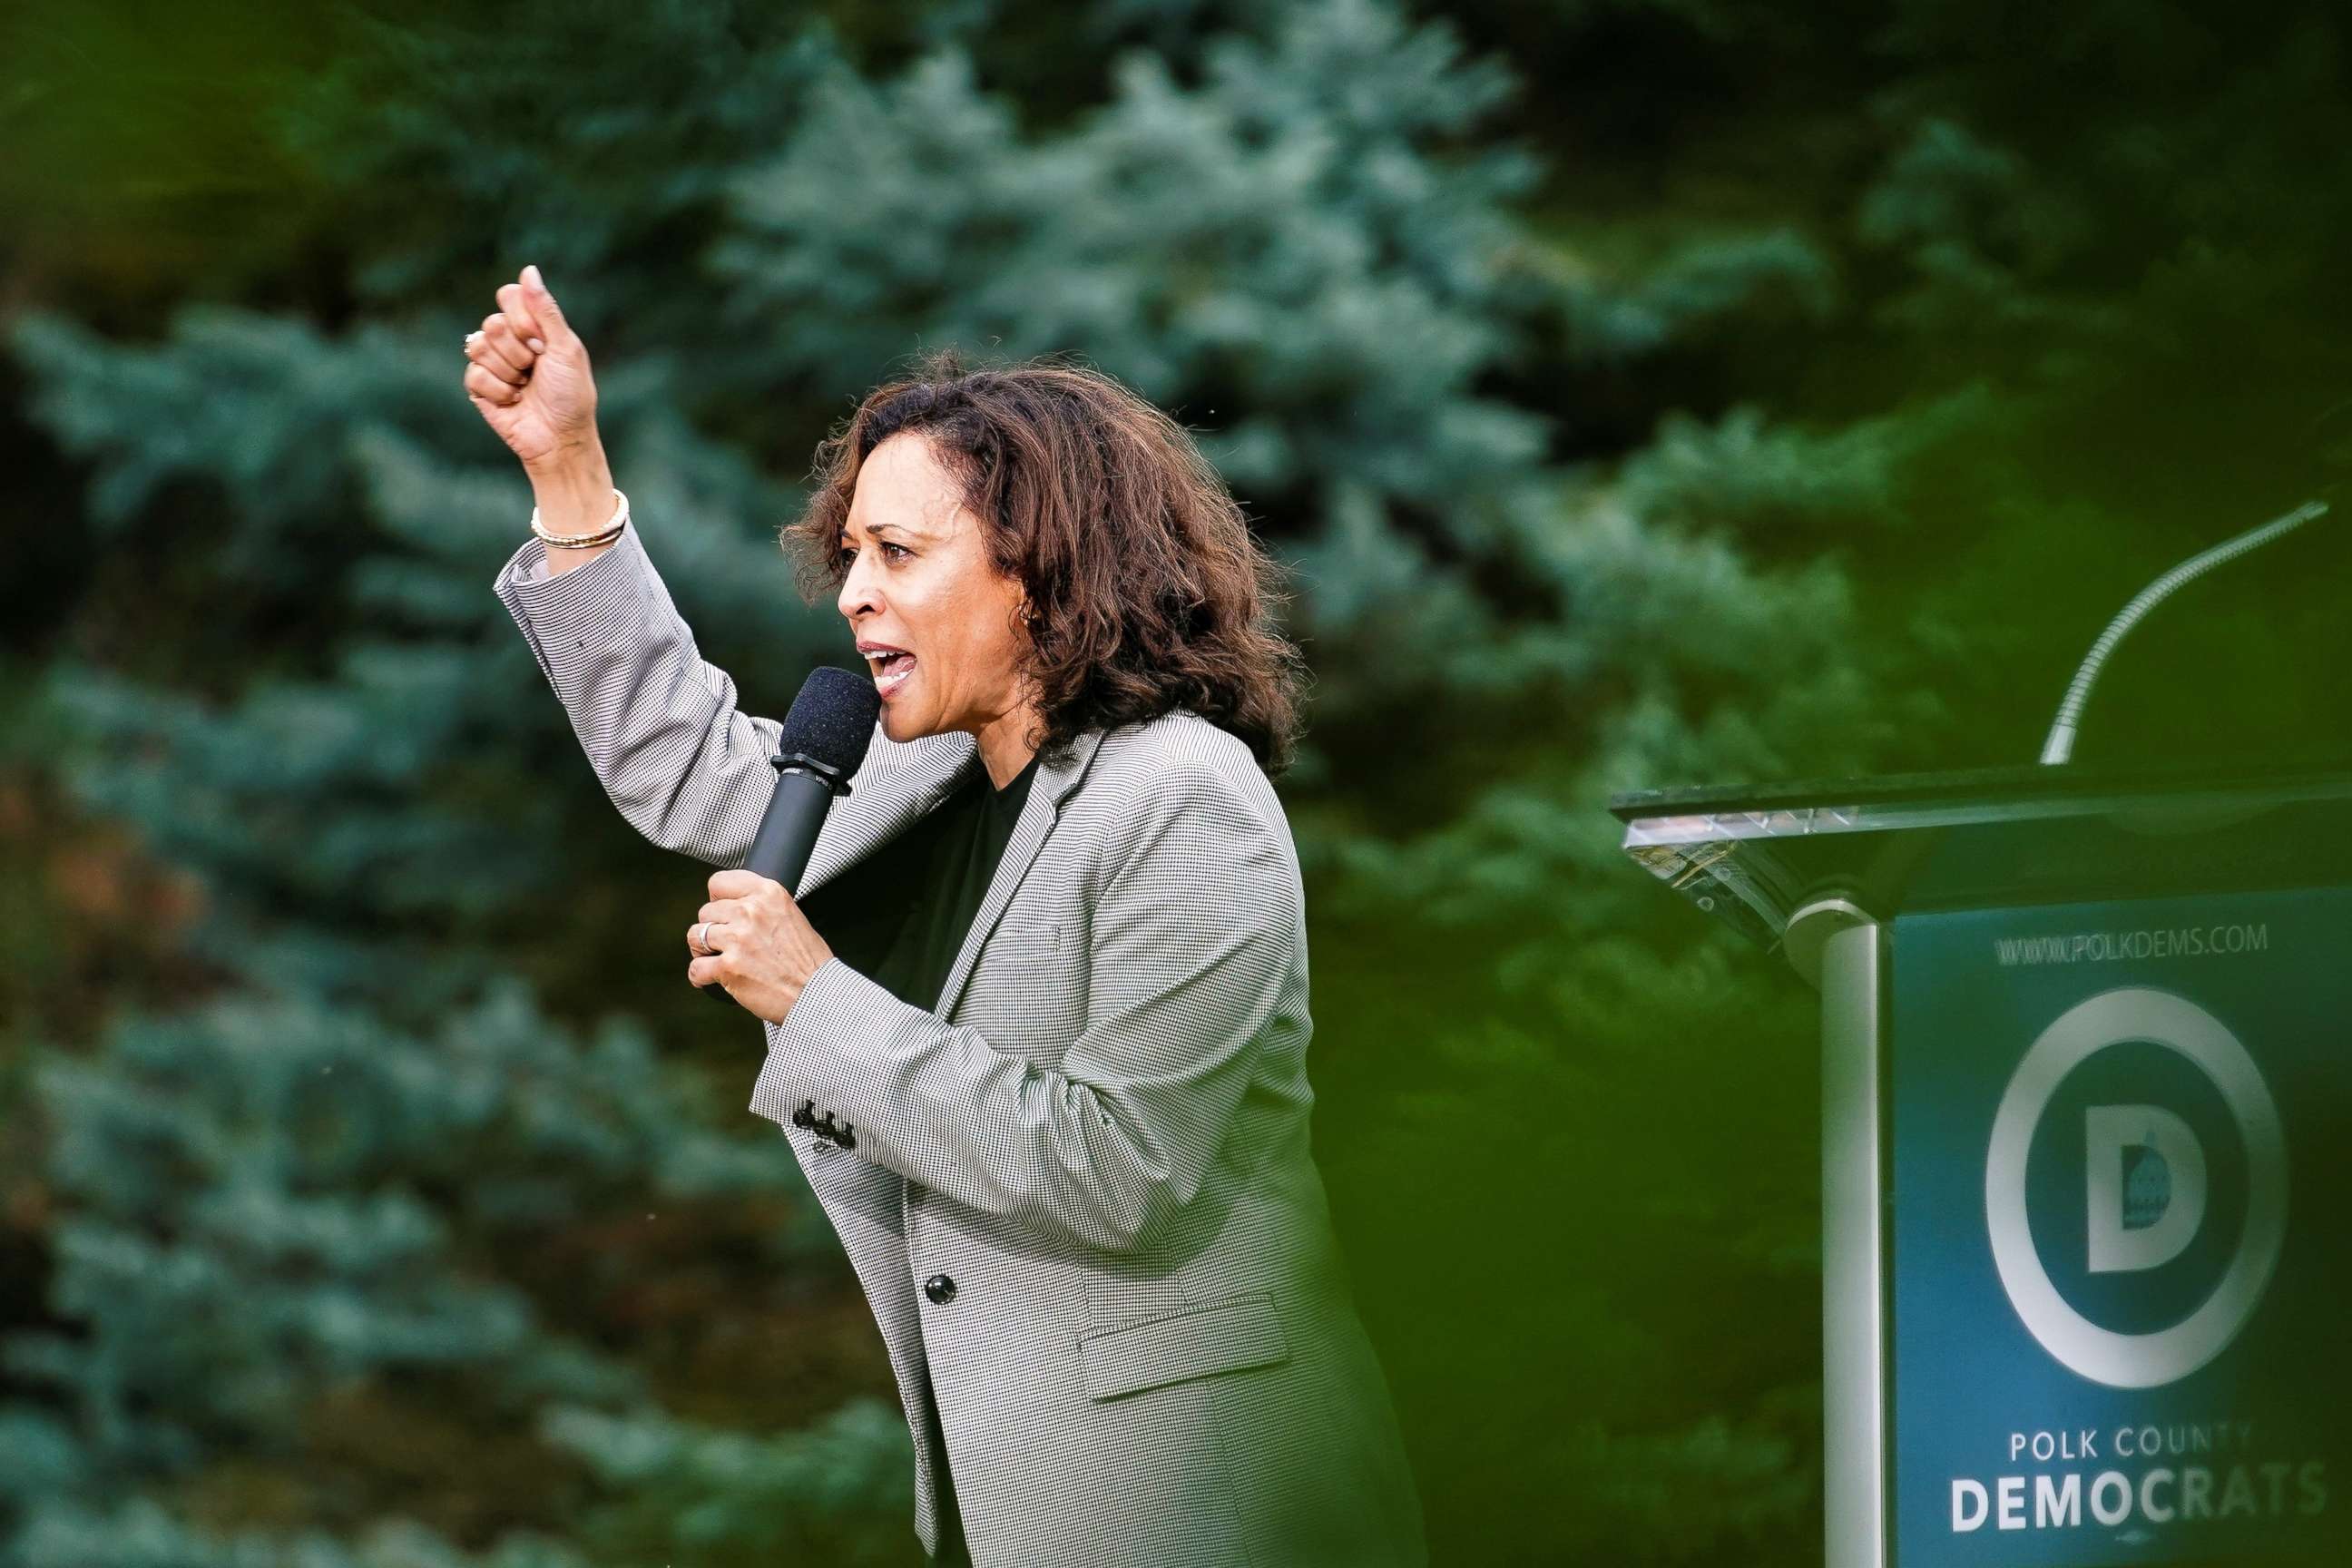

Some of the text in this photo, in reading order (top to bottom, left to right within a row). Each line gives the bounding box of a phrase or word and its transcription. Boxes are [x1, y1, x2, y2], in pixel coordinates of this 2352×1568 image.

[1996, 924, 2269, 965] WWW.POLKDEMS.COM
[2087, 1104, 2207, 1272] D
[2011, 1428, 2099, 1461] POLK
[1951, 1461, 2328, 1533] DEMOCRATS
